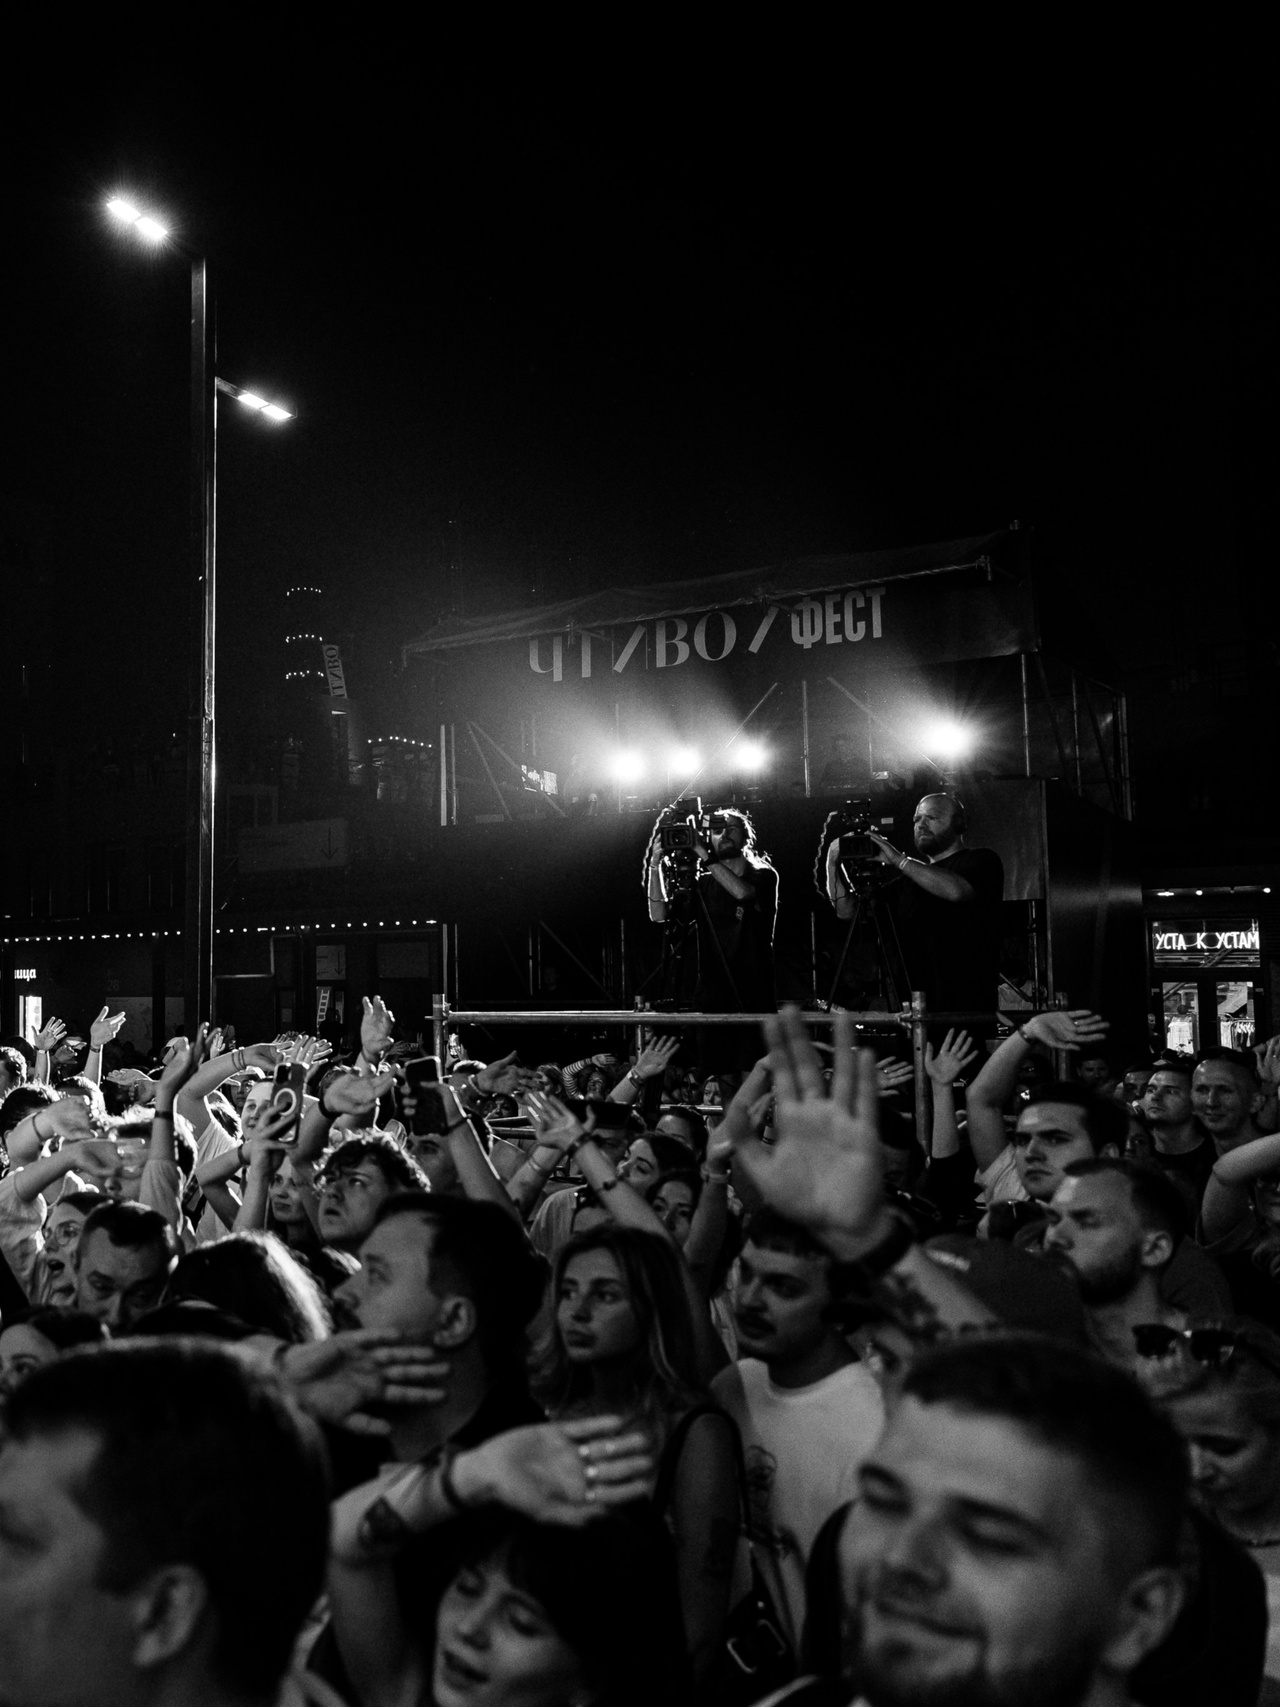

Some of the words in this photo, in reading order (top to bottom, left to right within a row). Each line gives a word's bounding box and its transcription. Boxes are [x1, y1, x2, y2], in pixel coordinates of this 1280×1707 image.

[790, 587, 887, 650] ФЕСТ
[1155, 932, 1187, 950] УСТА
[1196, 931, 1208, 950] К
[1214, 931, 1260, 950] УСТАМ
